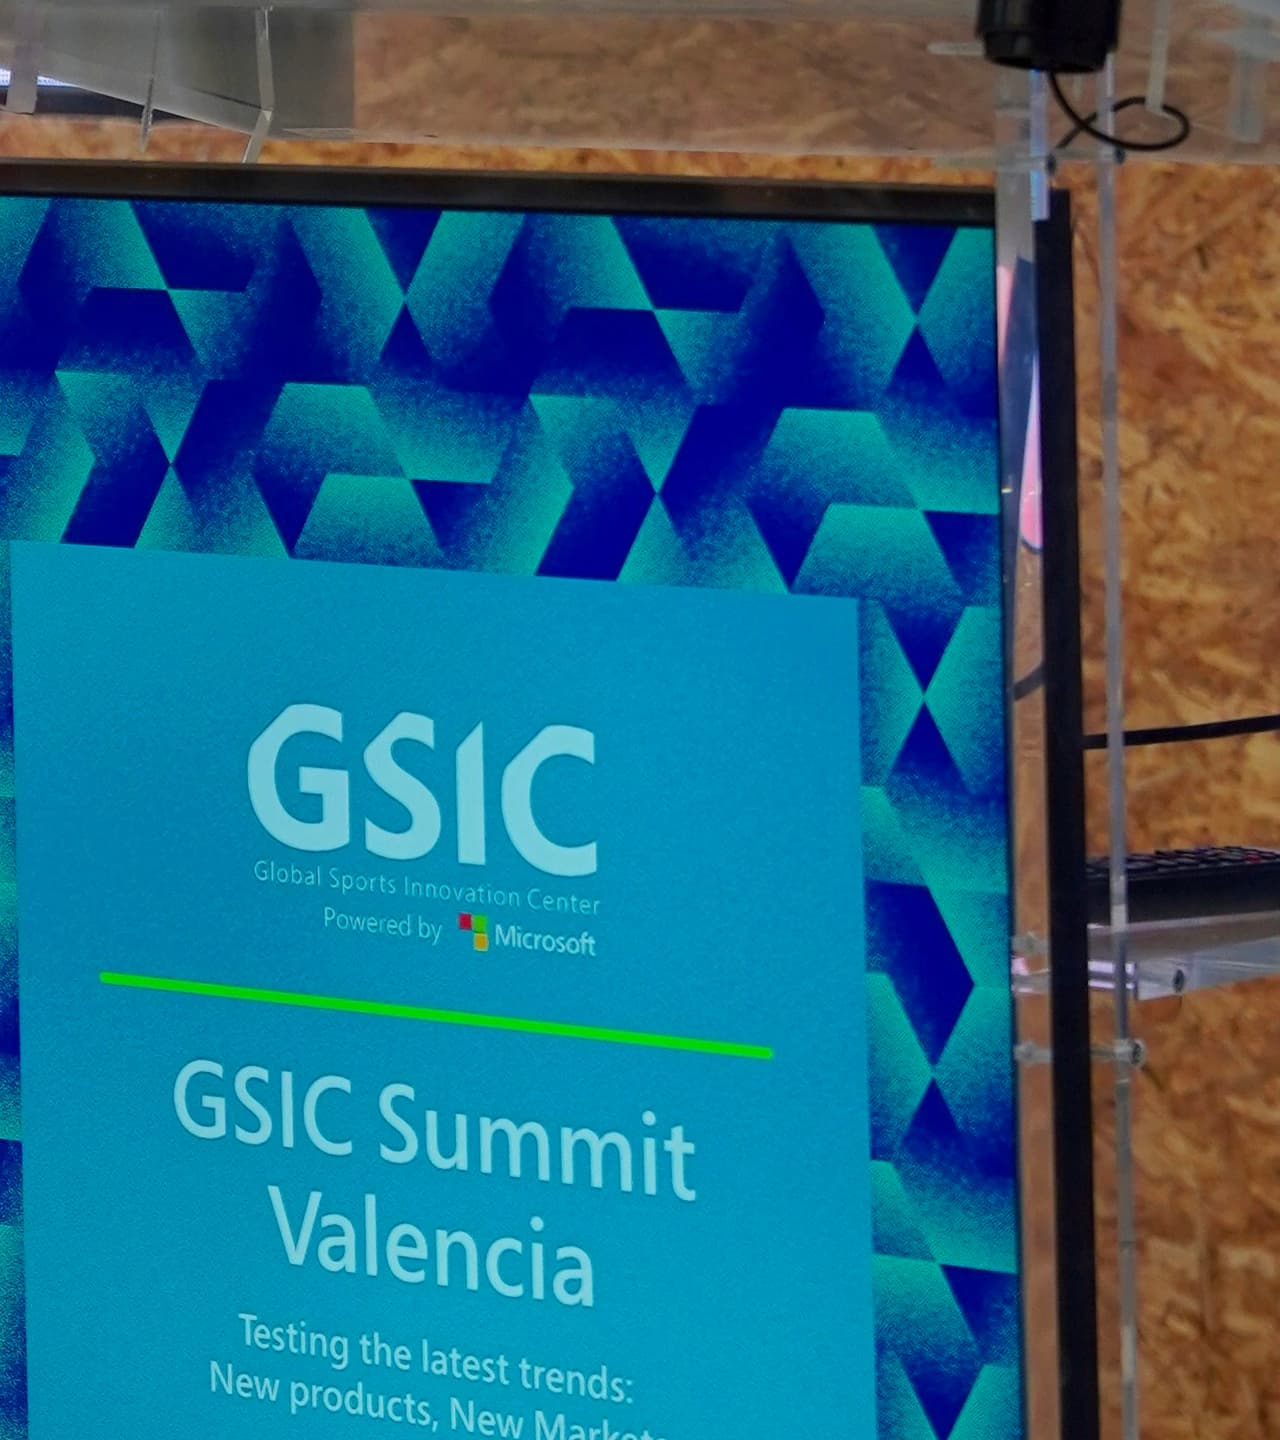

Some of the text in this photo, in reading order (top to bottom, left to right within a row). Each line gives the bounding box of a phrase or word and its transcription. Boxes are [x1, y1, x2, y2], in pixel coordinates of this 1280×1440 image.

[247, 703, 597, 877] GSIC
[254, 860, 599, 915] Global Sports Innovation Center
[324, 906, 596, 956] Powered by Microsoft
[173, 1059, 696, 1201] GSIC Summit
[267, 1185, 593, 1307] Valencia
[209, 1360, 279, 1402] New
[290, 1382, 439, 1432] products,
[450, 1398, 523, 1439] New
[239, 1313, 633, 1404] Testing the latest trends:
